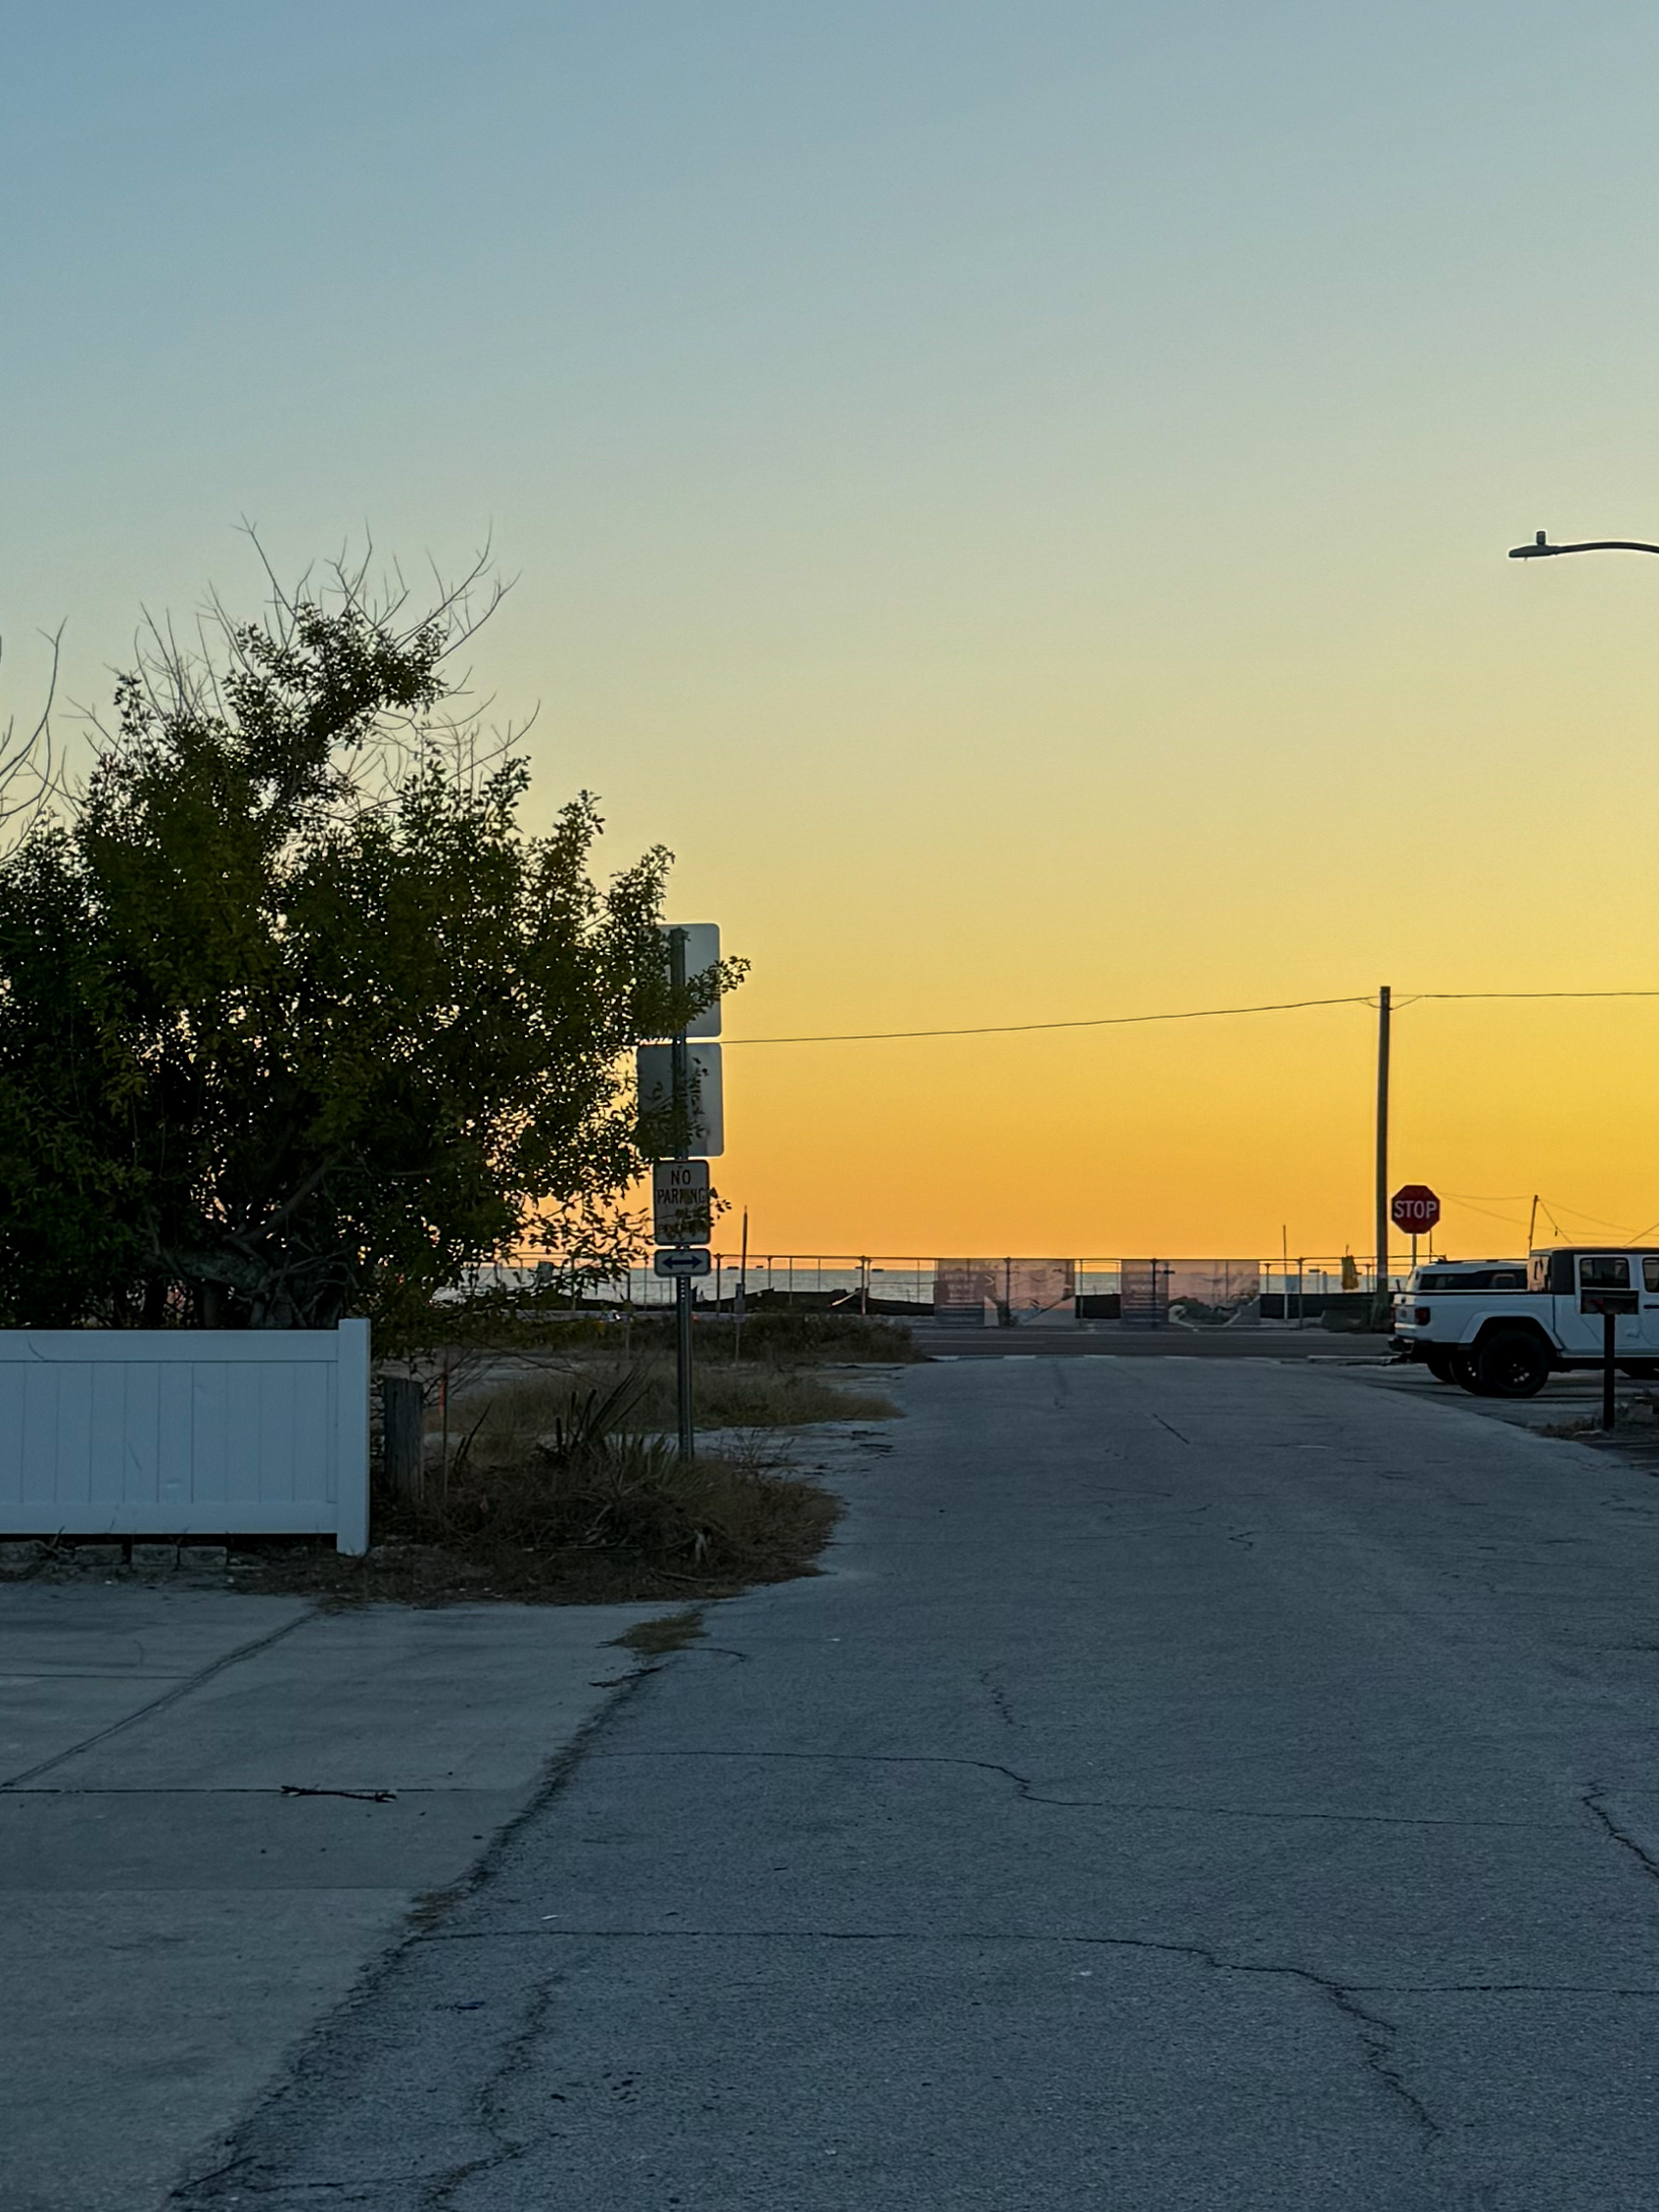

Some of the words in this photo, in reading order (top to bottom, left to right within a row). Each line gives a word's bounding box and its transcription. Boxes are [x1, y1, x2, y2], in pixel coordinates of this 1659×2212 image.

[671, 1169, 691, 1185] NO
[657, 1187, 705, 1205] PARNG
[1394, 1200, 1437, 1219] STOP
